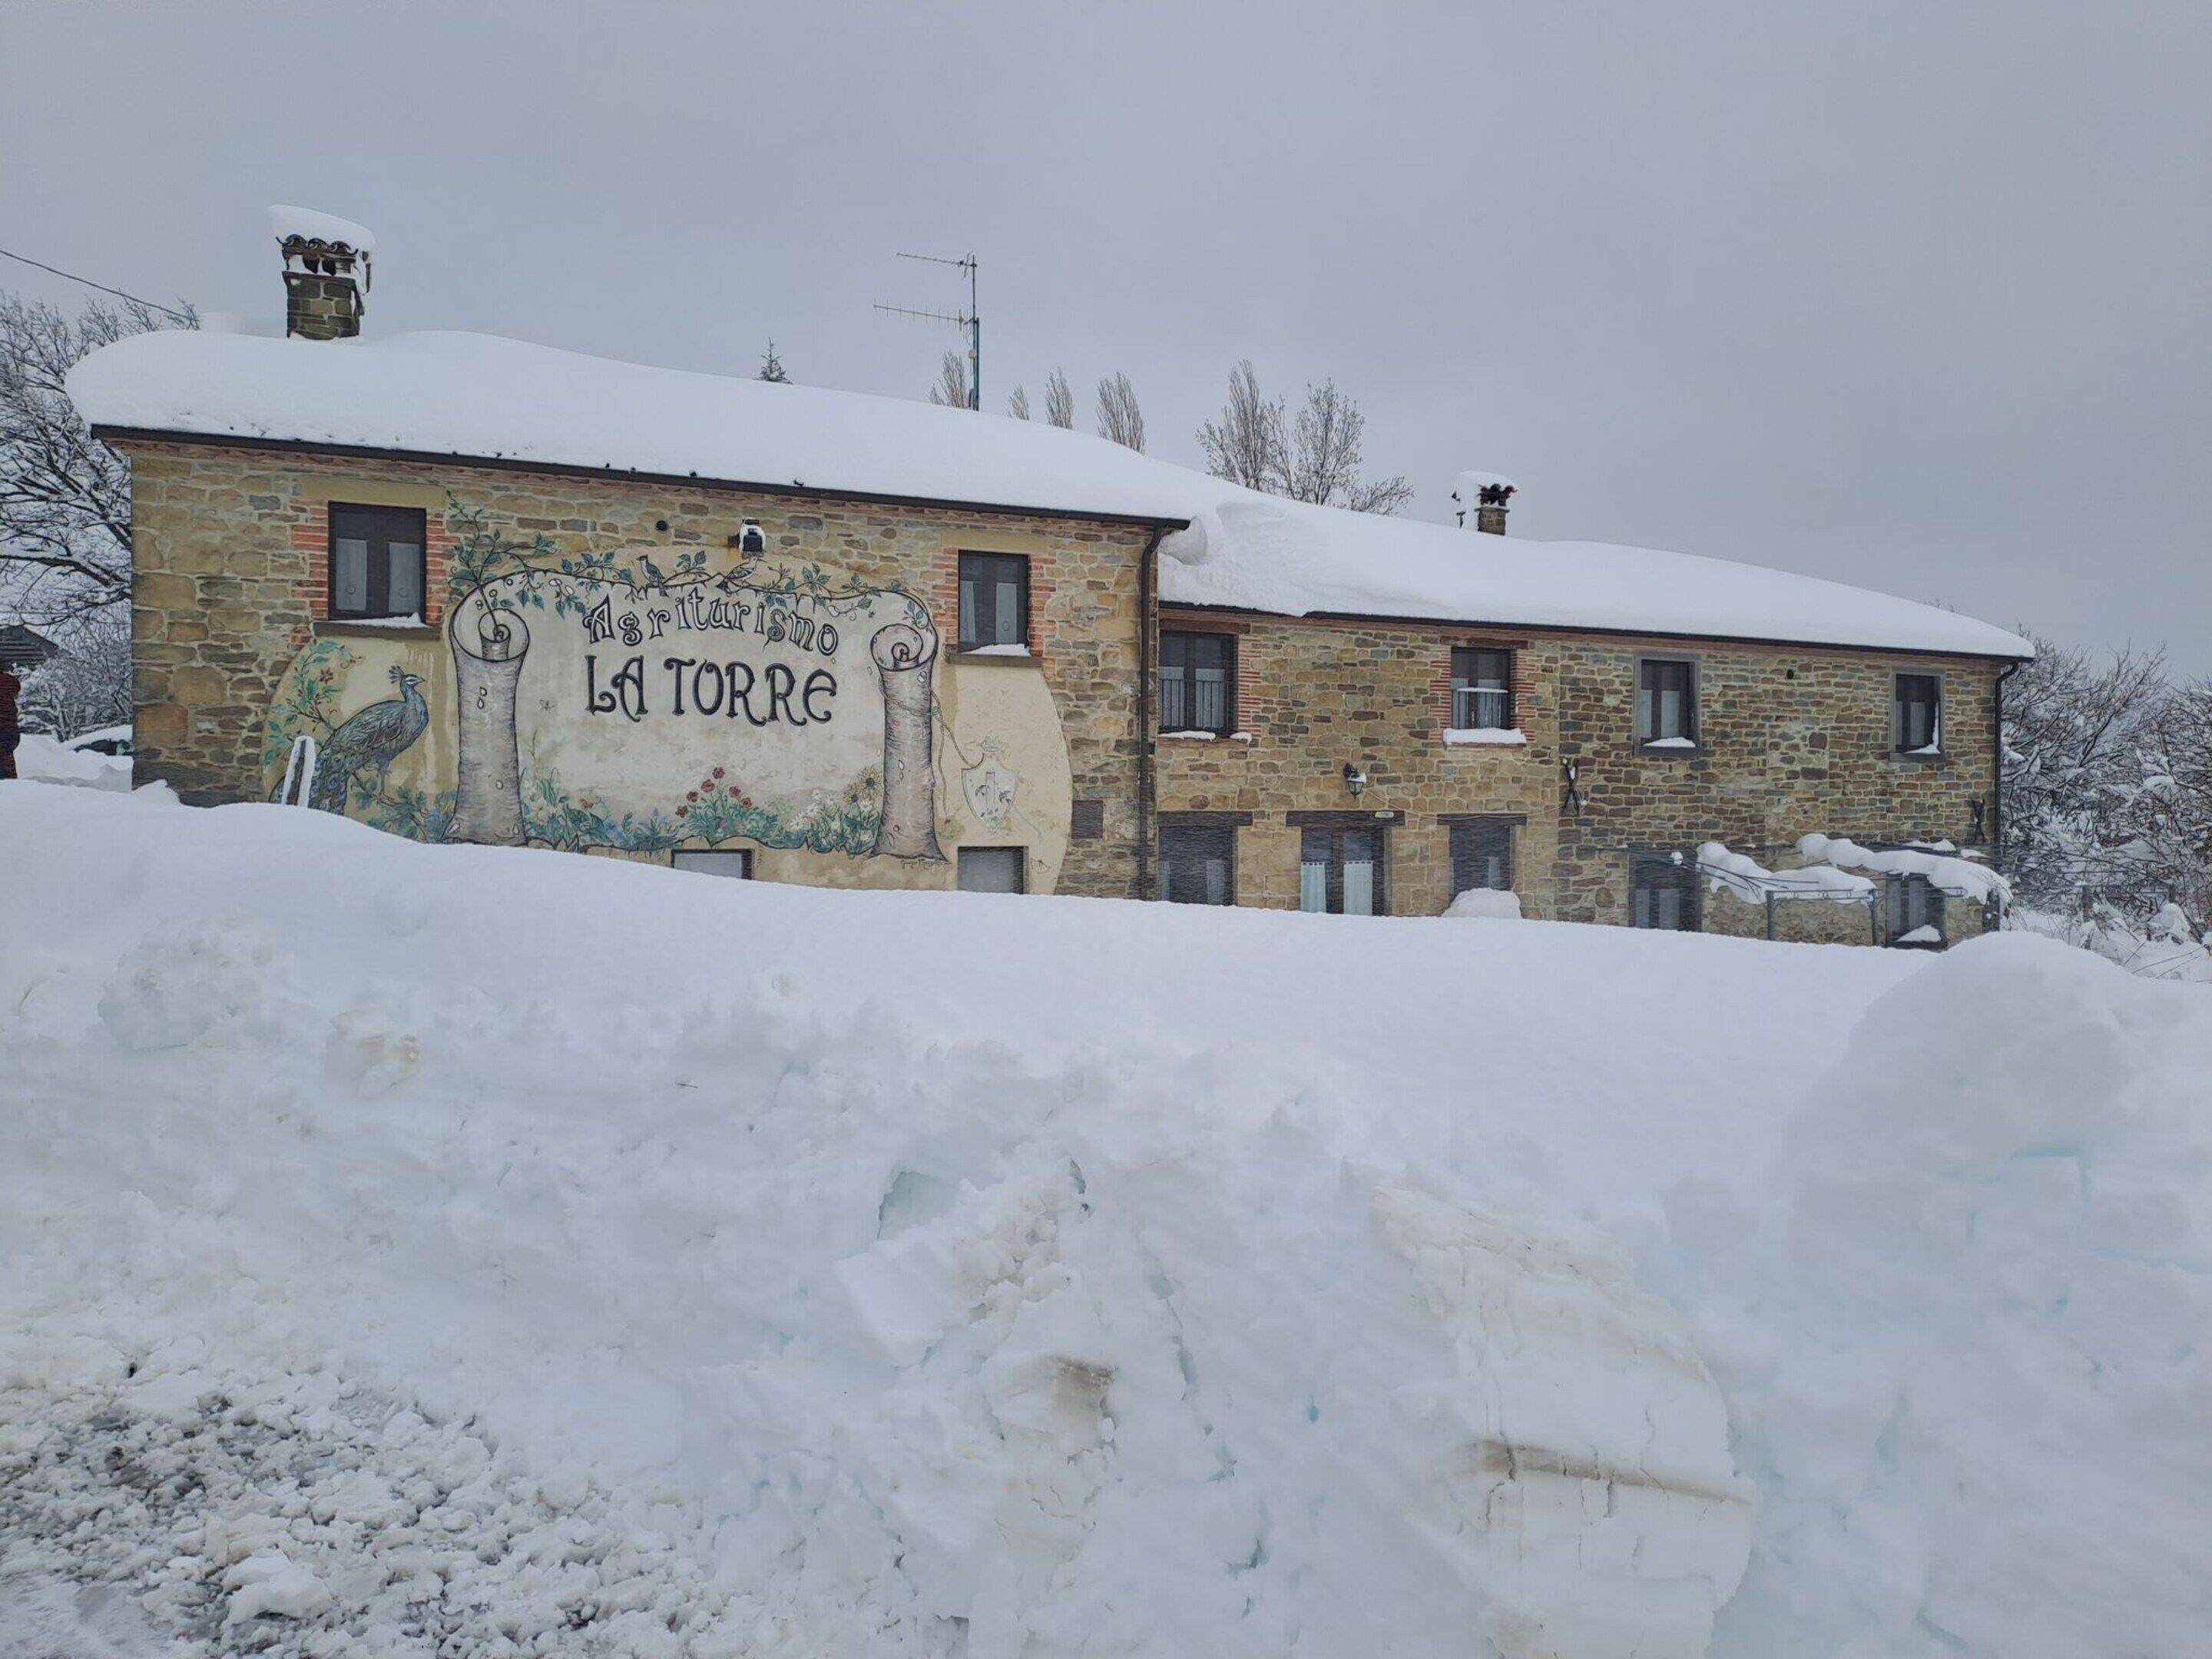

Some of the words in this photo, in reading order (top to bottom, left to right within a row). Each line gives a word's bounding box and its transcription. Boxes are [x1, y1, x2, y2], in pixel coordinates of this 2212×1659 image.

[582, 588, 838, 657] Agriturismo
[584, 654, 648, 722] LA
[664, 657, 838, 727] TORRE
